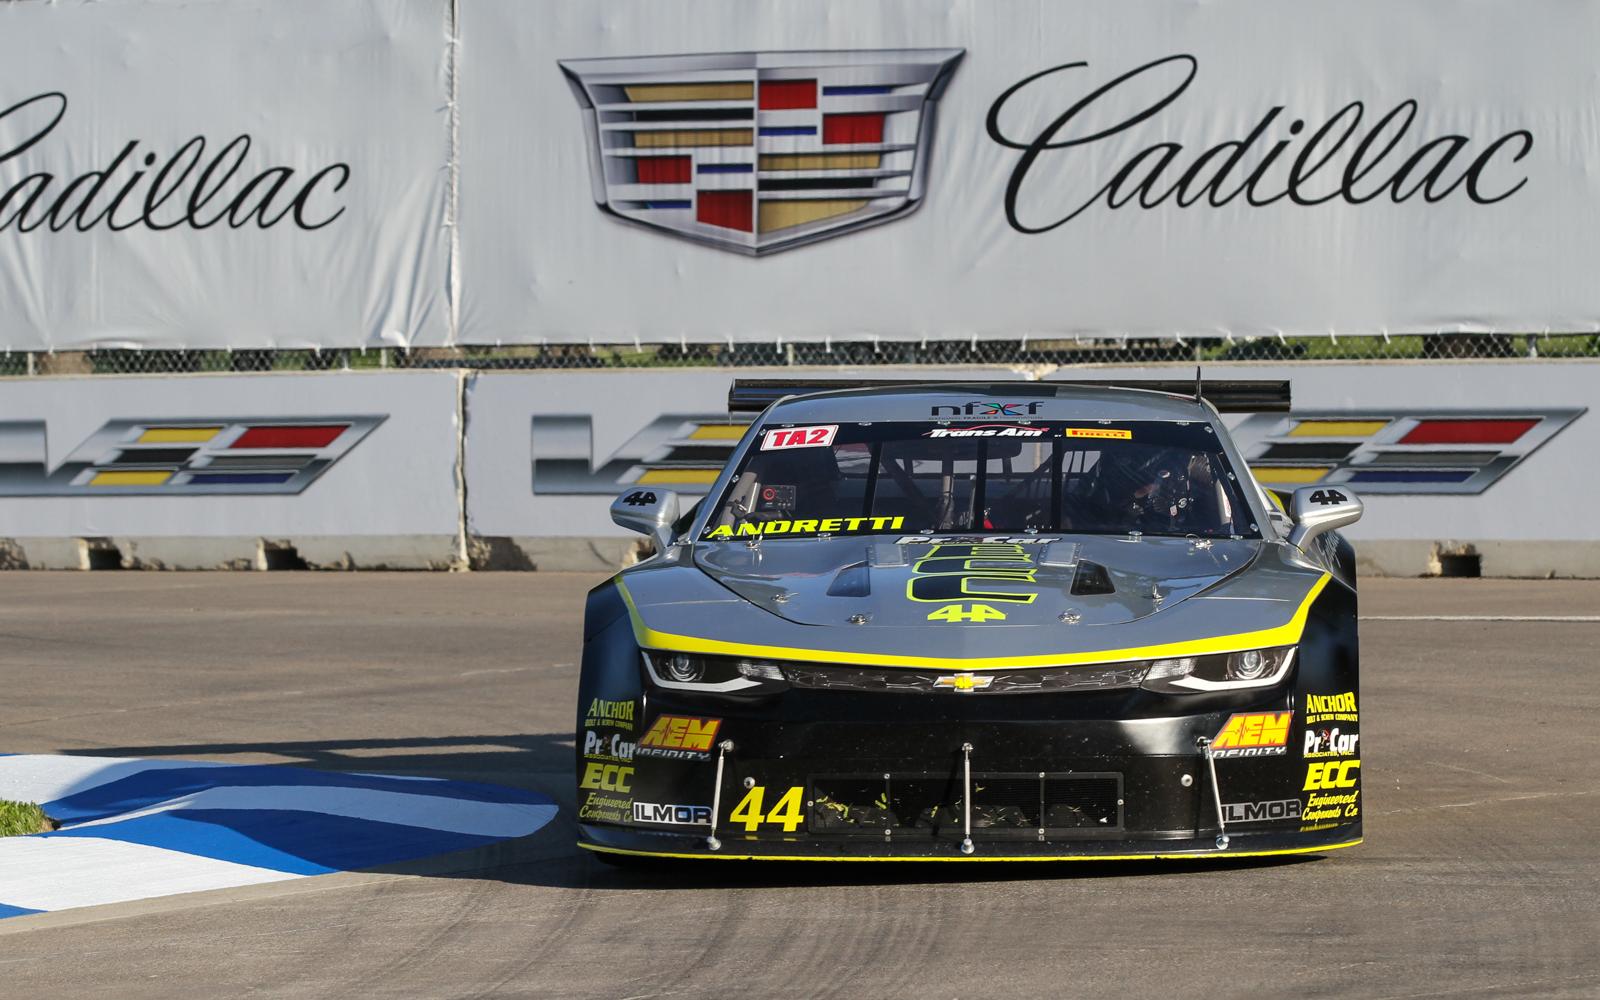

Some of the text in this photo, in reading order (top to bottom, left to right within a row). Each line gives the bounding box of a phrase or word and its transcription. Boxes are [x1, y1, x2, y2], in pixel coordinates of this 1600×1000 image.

[986, 54, 1533, 234] Cadillac
[772, 428, 829, 447] TA2
[930, 428, 998, 438] Trans
[1000, 427, 1043, 437] Am
[1071, 429, 1126, 438] PIRELLI
[706, 516, 905, 539] ANDRETTI
[587, 697, 634, 720] ANCHOR
[1306, 691, 1358, 713] ANCHOR
[1335, 713, 1358, 722] COMPANY
[641, 716, 720, 750] AEM
[1212, 713, 1291, 747] AEM
[1210, 747, 1287, 758] NFINITY
[579, 762, 635, 793] ECC
[1302, 760, 1361, 791] ECC
[585, 792, 634, 809] Engineered
[729, 787, 805, 832] 44
[1308, 790, 1359, 809] Engineered
[580, 805, 621, 821] Components
[634, 803, 713, 824] ILMOR
[1221, 800, 1300, 822] ILMOR
[1302, 804, 1358, 823] Components Co
